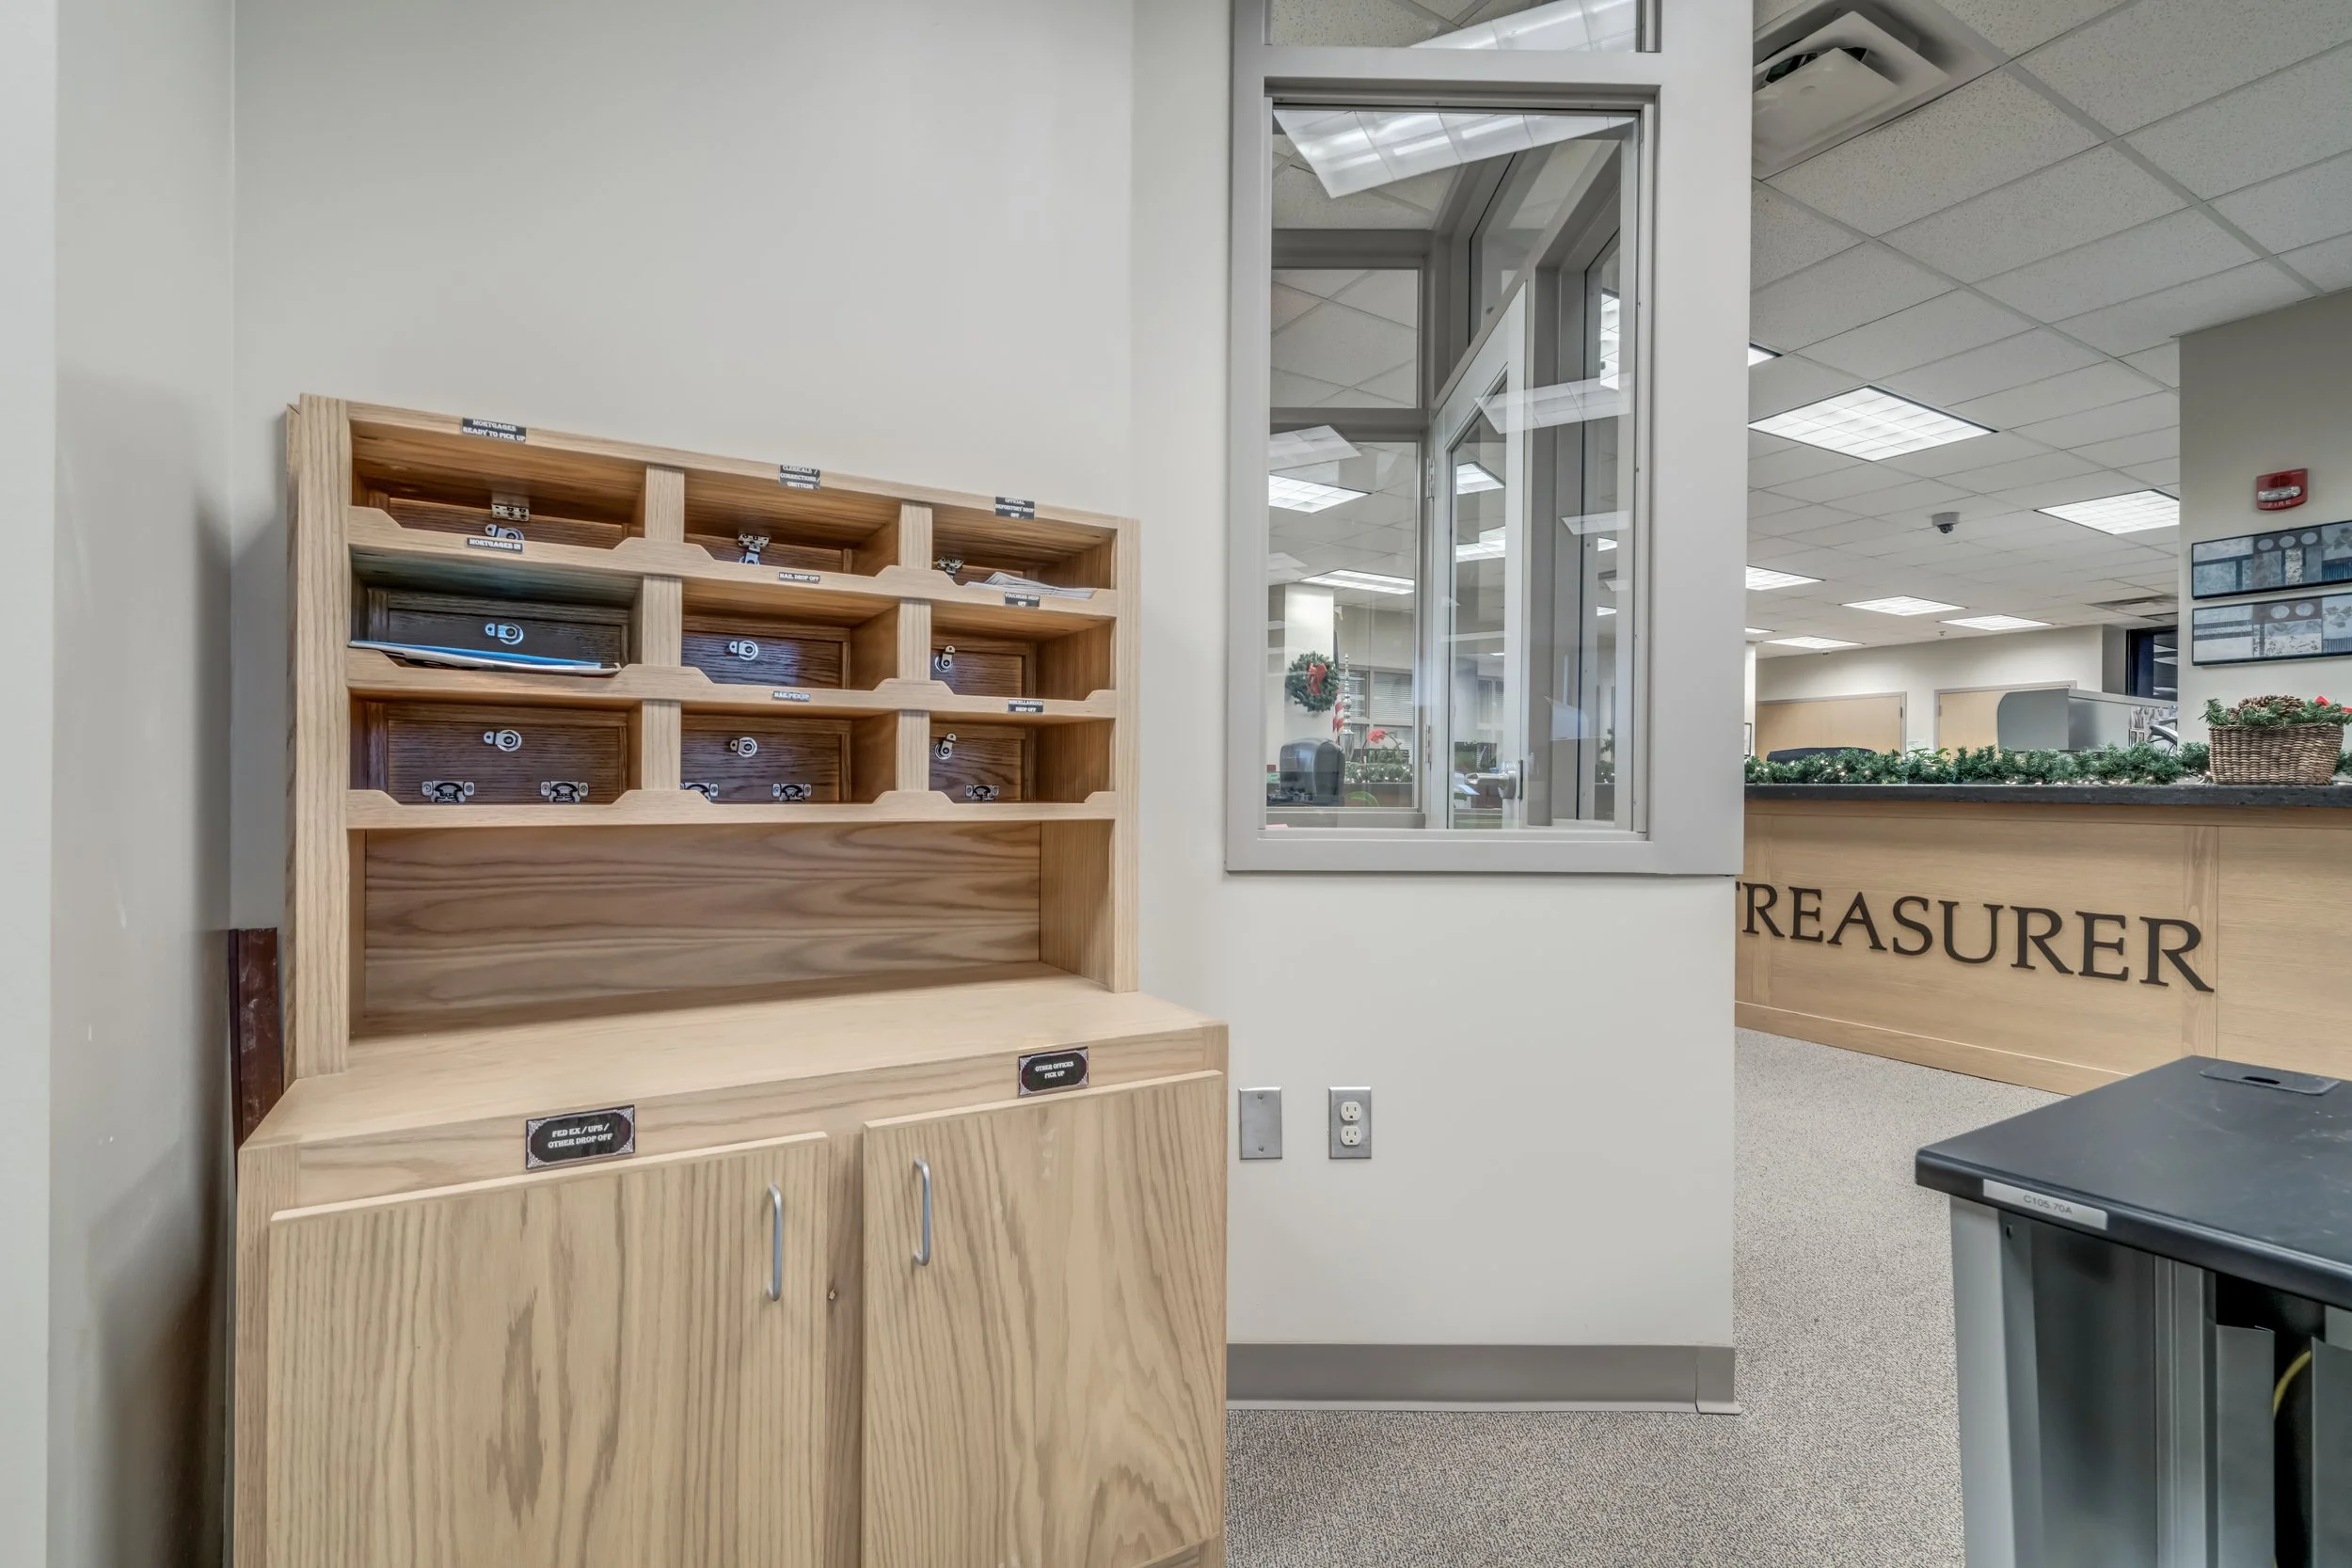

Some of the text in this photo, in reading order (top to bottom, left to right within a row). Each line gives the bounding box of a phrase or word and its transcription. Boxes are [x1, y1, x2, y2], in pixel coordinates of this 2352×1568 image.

[463, 426, 487, 436] READY
[472, 419, 516, 432] MORTGAGES
[2267, 499, 2292, 508] FIRE
[469, 539, 513, 549] MORTGAGES
[1736, 881, 2215, 993] REASURER
[1035, 1061, 1074, 1072] OTHER OFFICES
[551, 1129, 568, 1138] FED
[588, 1124, 604, 1133] UPS
[548, 1132, 613, 1149] OTHER DROP OFF
[2023, 1195, 2073, 1215] C105.70A
